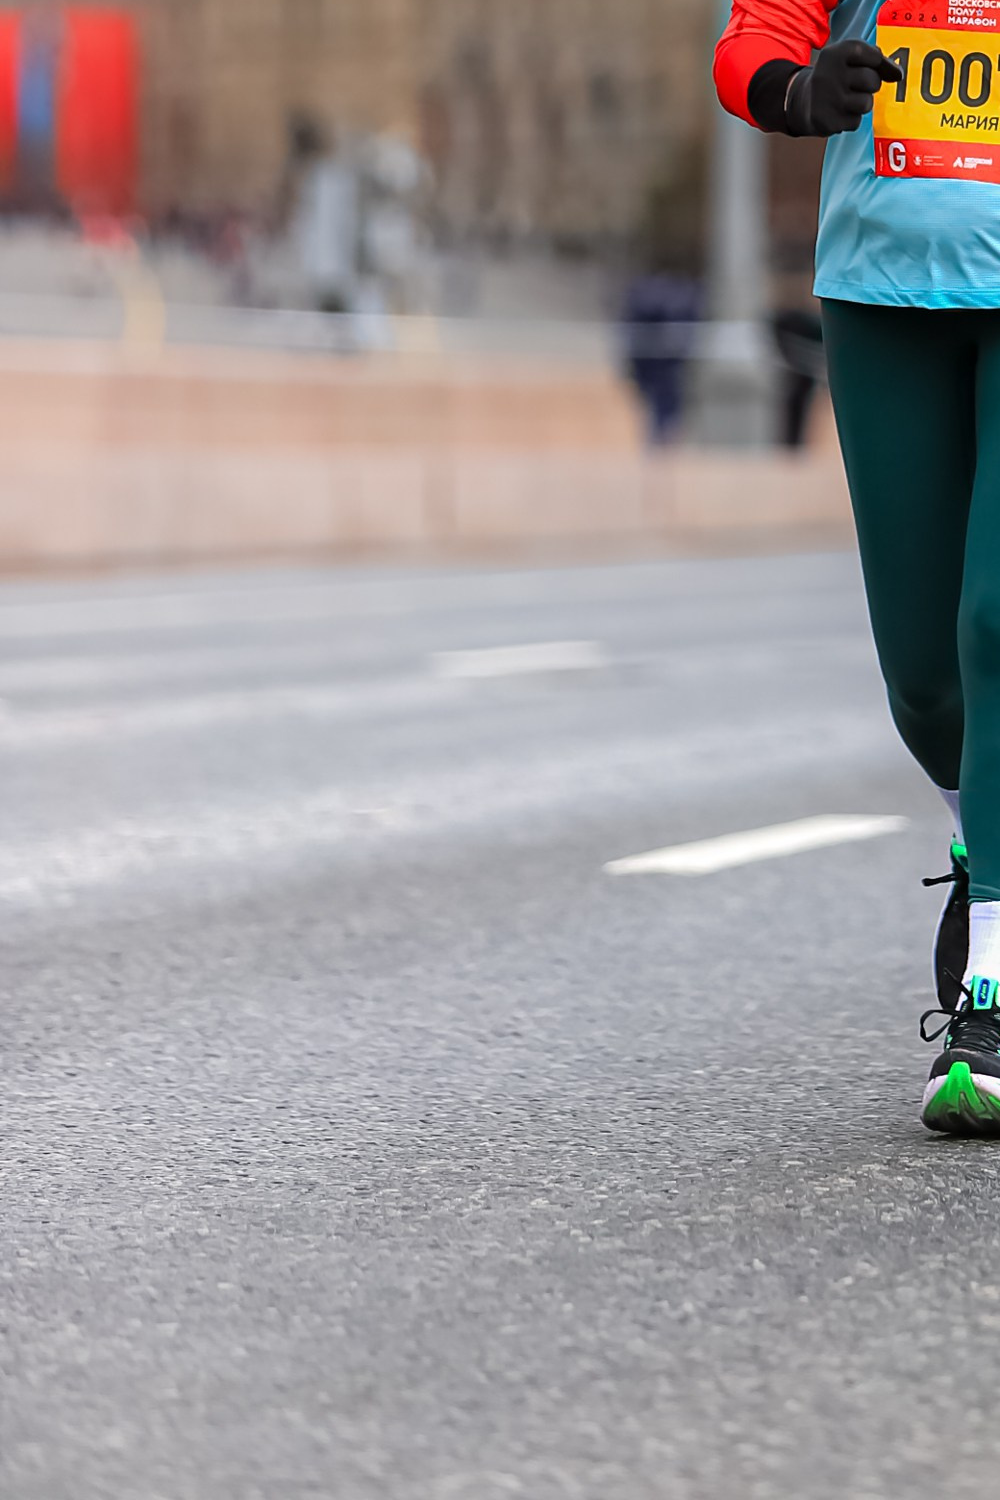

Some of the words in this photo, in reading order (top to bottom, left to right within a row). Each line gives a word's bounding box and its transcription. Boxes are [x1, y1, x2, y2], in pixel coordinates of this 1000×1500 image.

[948, 8, 976, 16] ПОЛУ
[947, 16, 997, 27] МАРАФОН
[940, 113, 1000, 131] МАРИЯ
[888, 141, 907, 172] G
